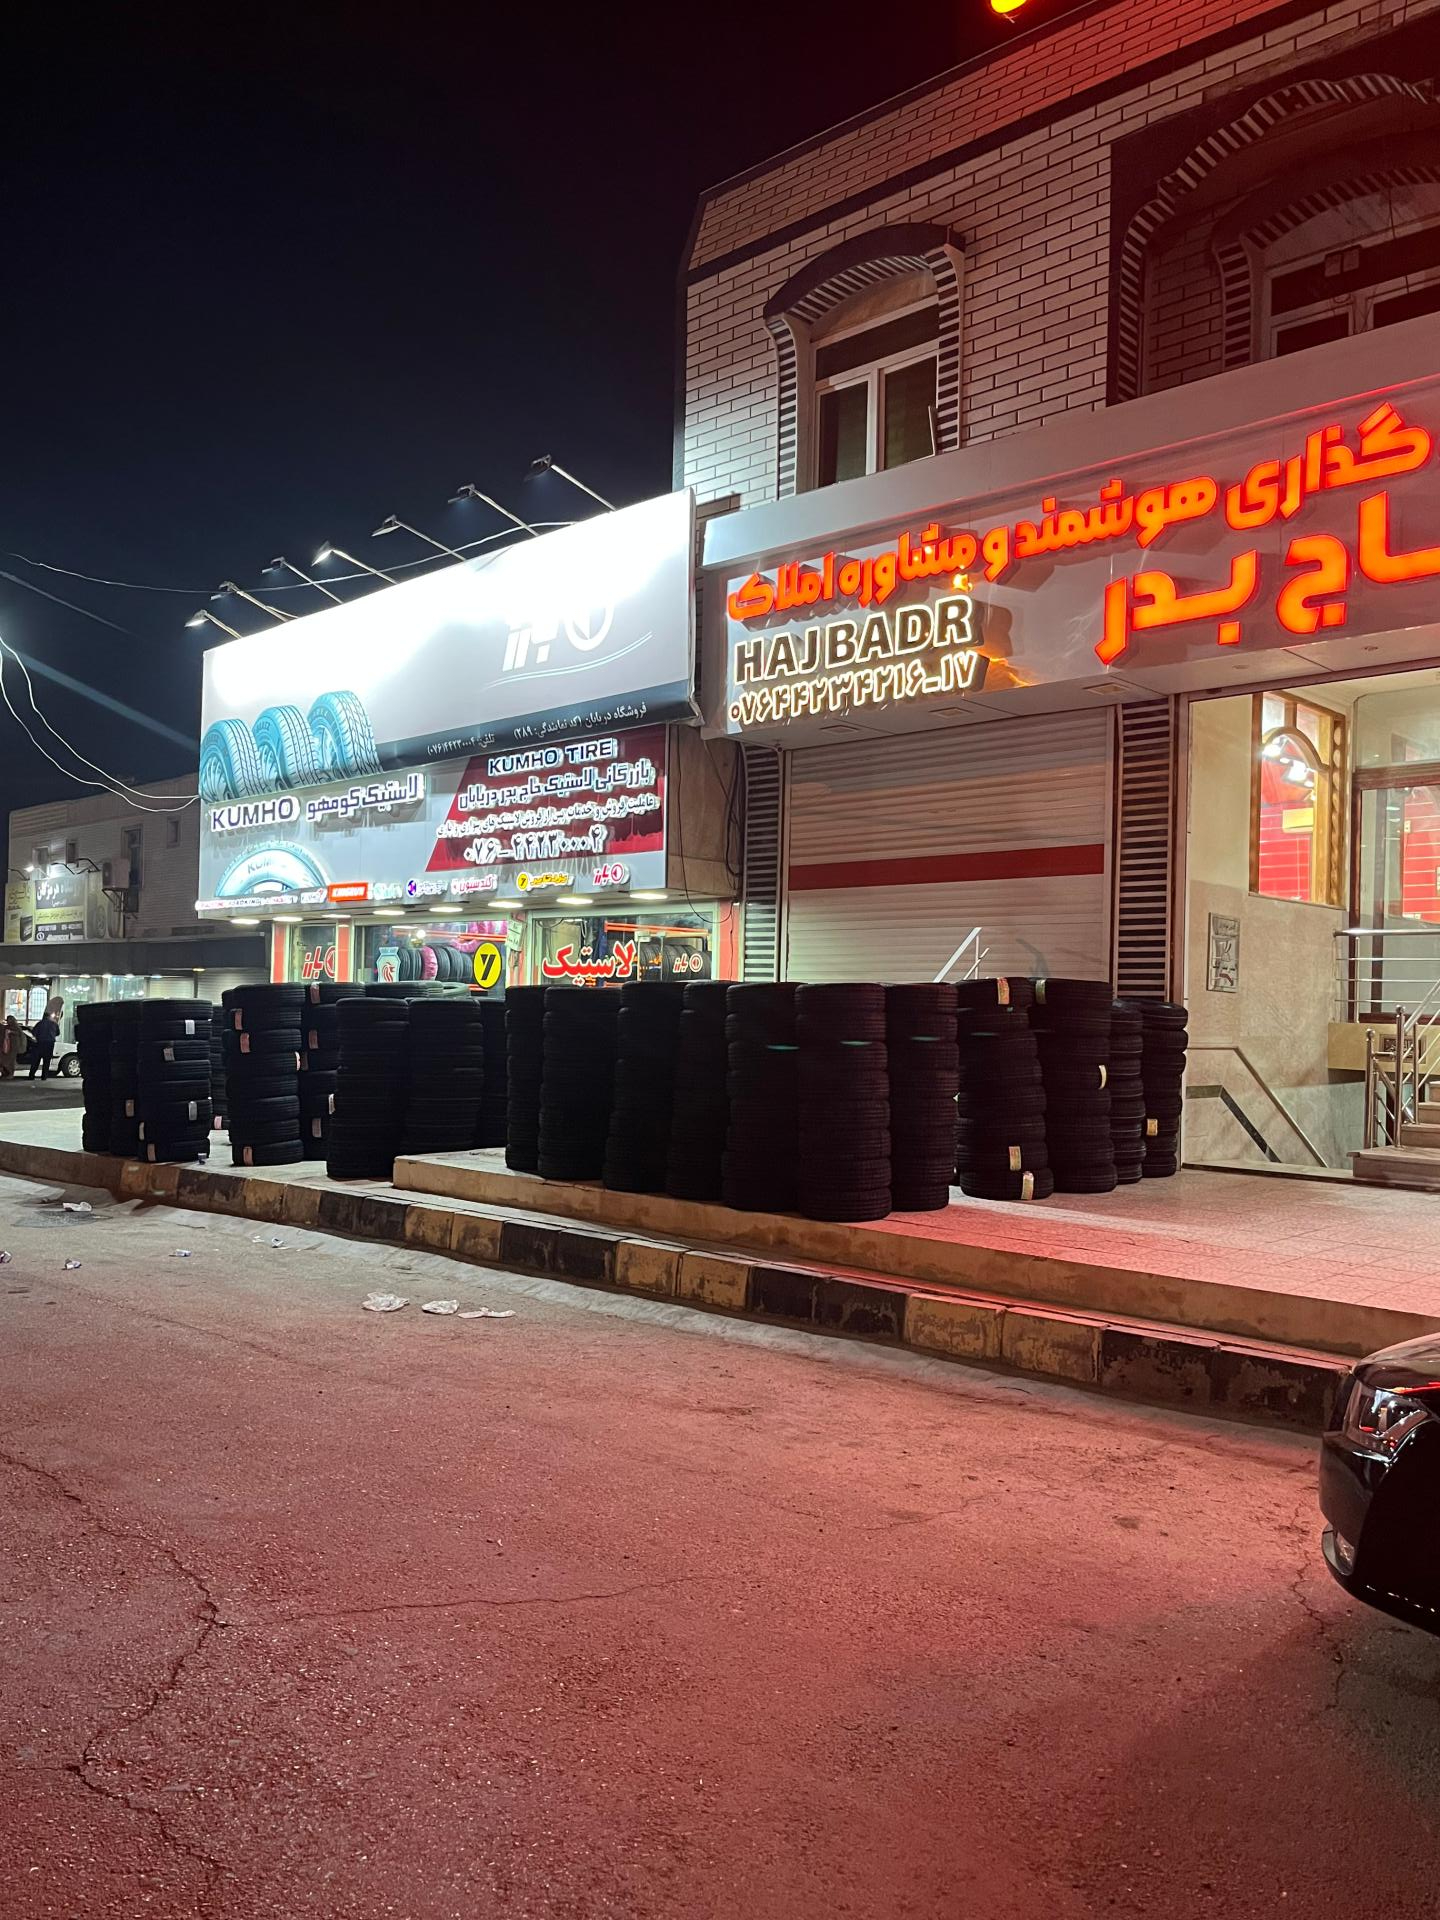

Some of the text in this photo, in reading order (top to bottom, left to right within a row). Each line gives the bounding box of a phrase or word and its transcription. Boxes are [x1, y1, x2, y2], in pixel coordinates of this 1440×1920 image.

[727, 402, 1431, 621] گذاری هوشمند و مشاوره املاک
[1094, 490, 1440, 666] اج بدر
[613, 701, 647, 719] فروشگاه
[488, 740, 615, 775] KUMHO TIRE
[307, 775, 419, 820] لاستیک کومهو
[459, 760, 650, 810] بازرگانی لاستیک حاج بدر دریابان
[627, 793, 656, 811] عاملیت
[212, 797, 294, 830] KUMHO
[602, 797, 625, 817] فروش
[541, 940, 637, 986] لاستیک
